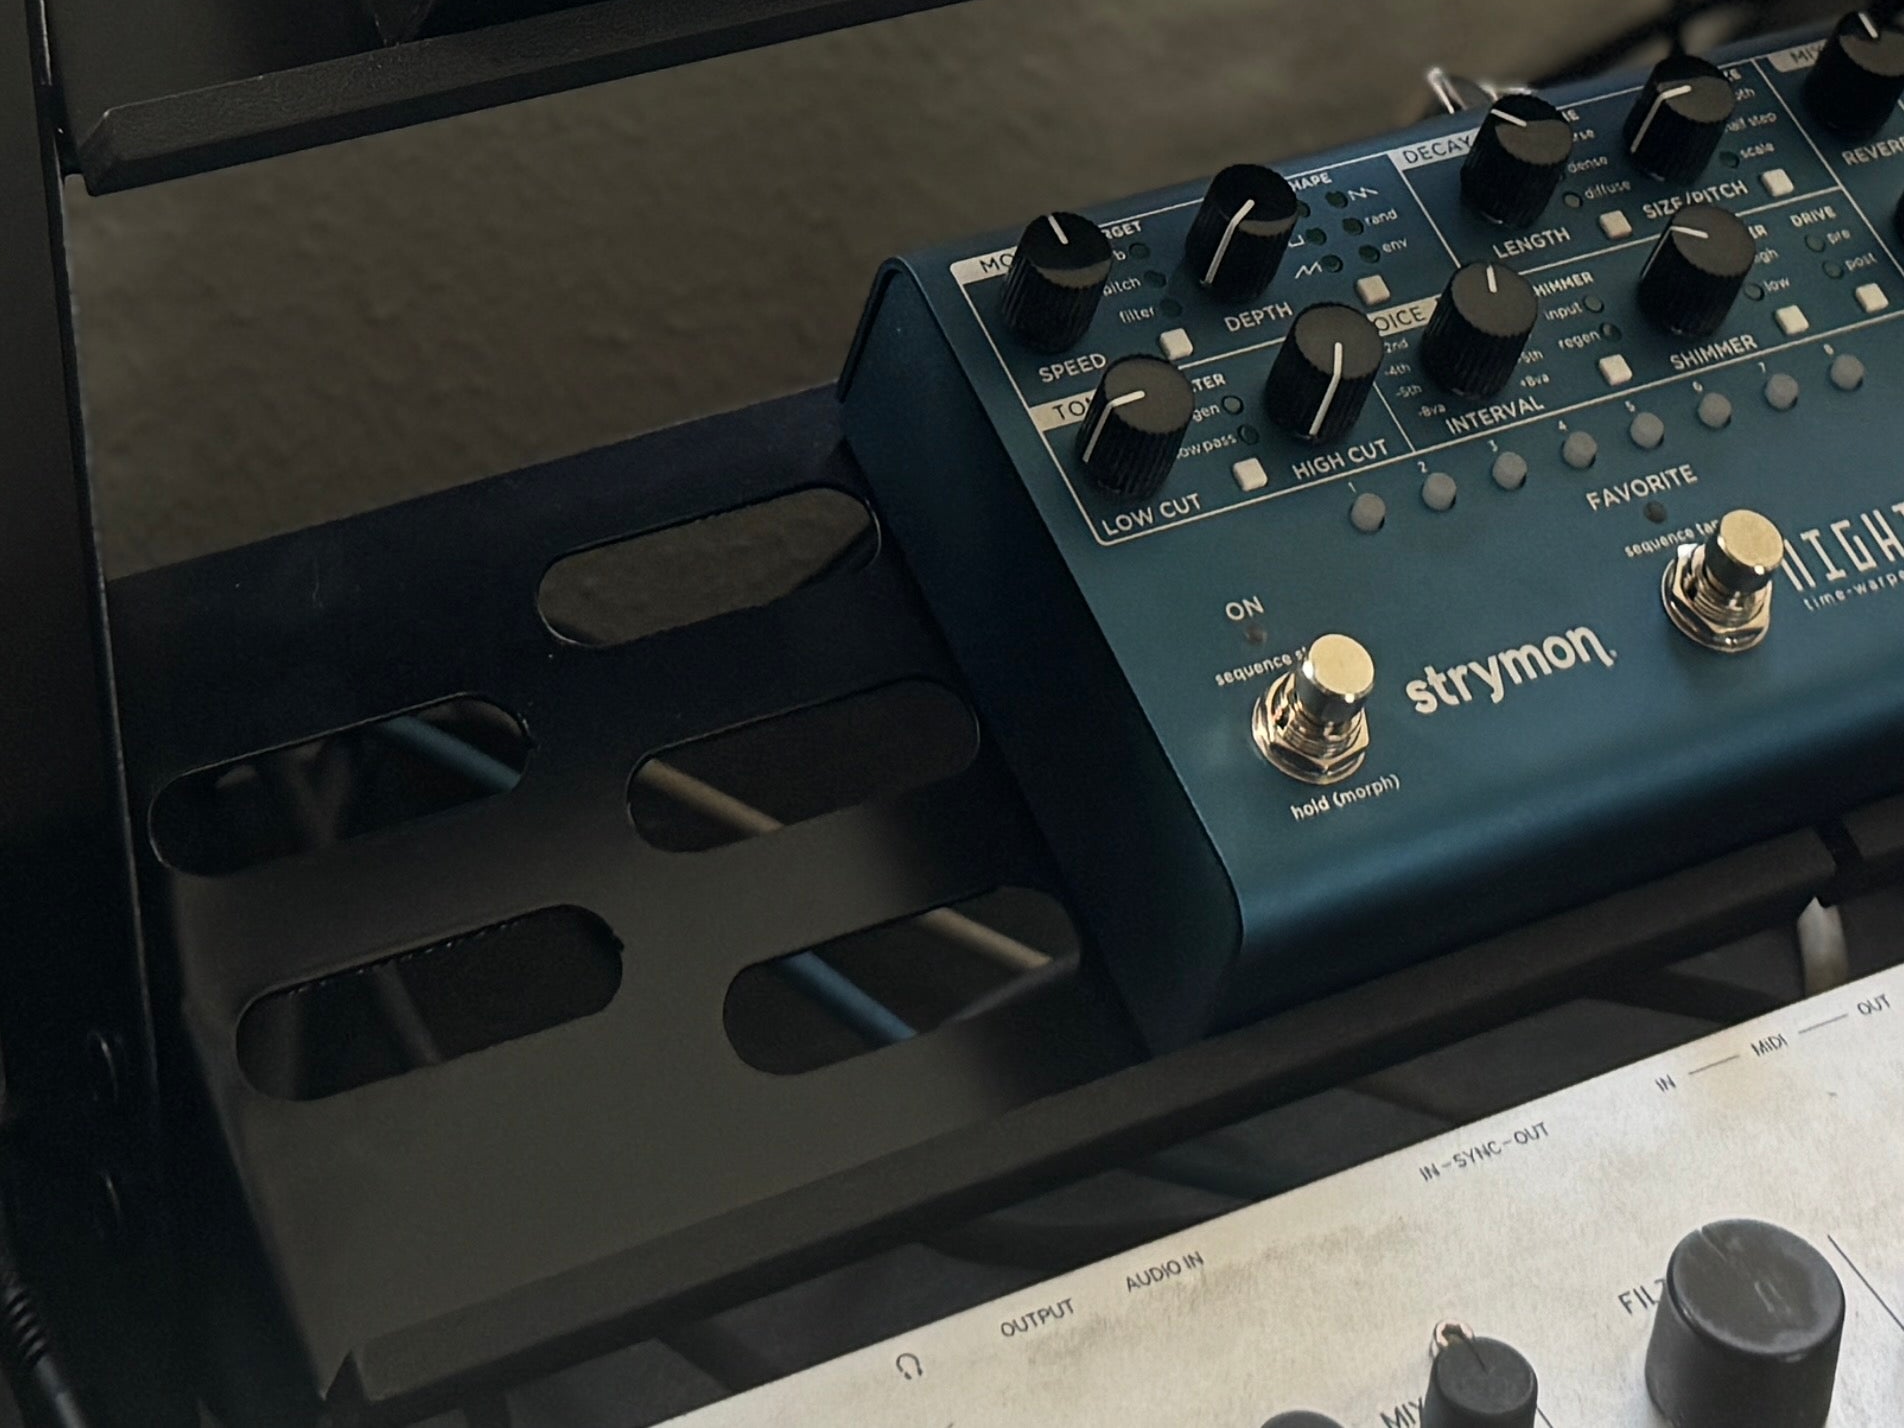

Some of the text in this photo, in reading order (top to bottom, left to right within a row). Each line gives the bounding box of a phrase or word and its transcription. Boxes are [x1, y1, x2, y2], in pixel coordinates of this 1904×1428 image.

[1402, 134, 1475, 165] DECAY
[1364, 207, 1398, 228] rand
[1789, 205, 1837, 228] DRIVE
[1381, 236, 1409, 254] env
[1492, 227, 1572, 260] LENGTH
[1223, 301, 1294, 333] DEPTH
[1544, 301, 1583, 322] input
[1038, 352, 1108, 384] SPEED
[1669, 333, 1758, 371] SHIMMER
[1445, 395, 1545, 435] INTERVAL
[1292, 439, 1390, 481] HIGH CUT
[1585, 463, 1698, 512] FAVORITE
[1101, 492, 1202, 536] LOW CUT
[1624, 526, 1696, 559] sequence
[1224, 594, 1266, 622] ON
[1213, 652, 1294, 688] sequence
[1405, 625, 1616, 715] strymon
[1289, 772, 1402, 822] hold (morph)
[1654, 994, 1892, 1094] IN MIDI OUT
[1124, 1250, 1206, 1294] AUDIO IN
[999, 1297, 1077, 1339] OUTPUT
